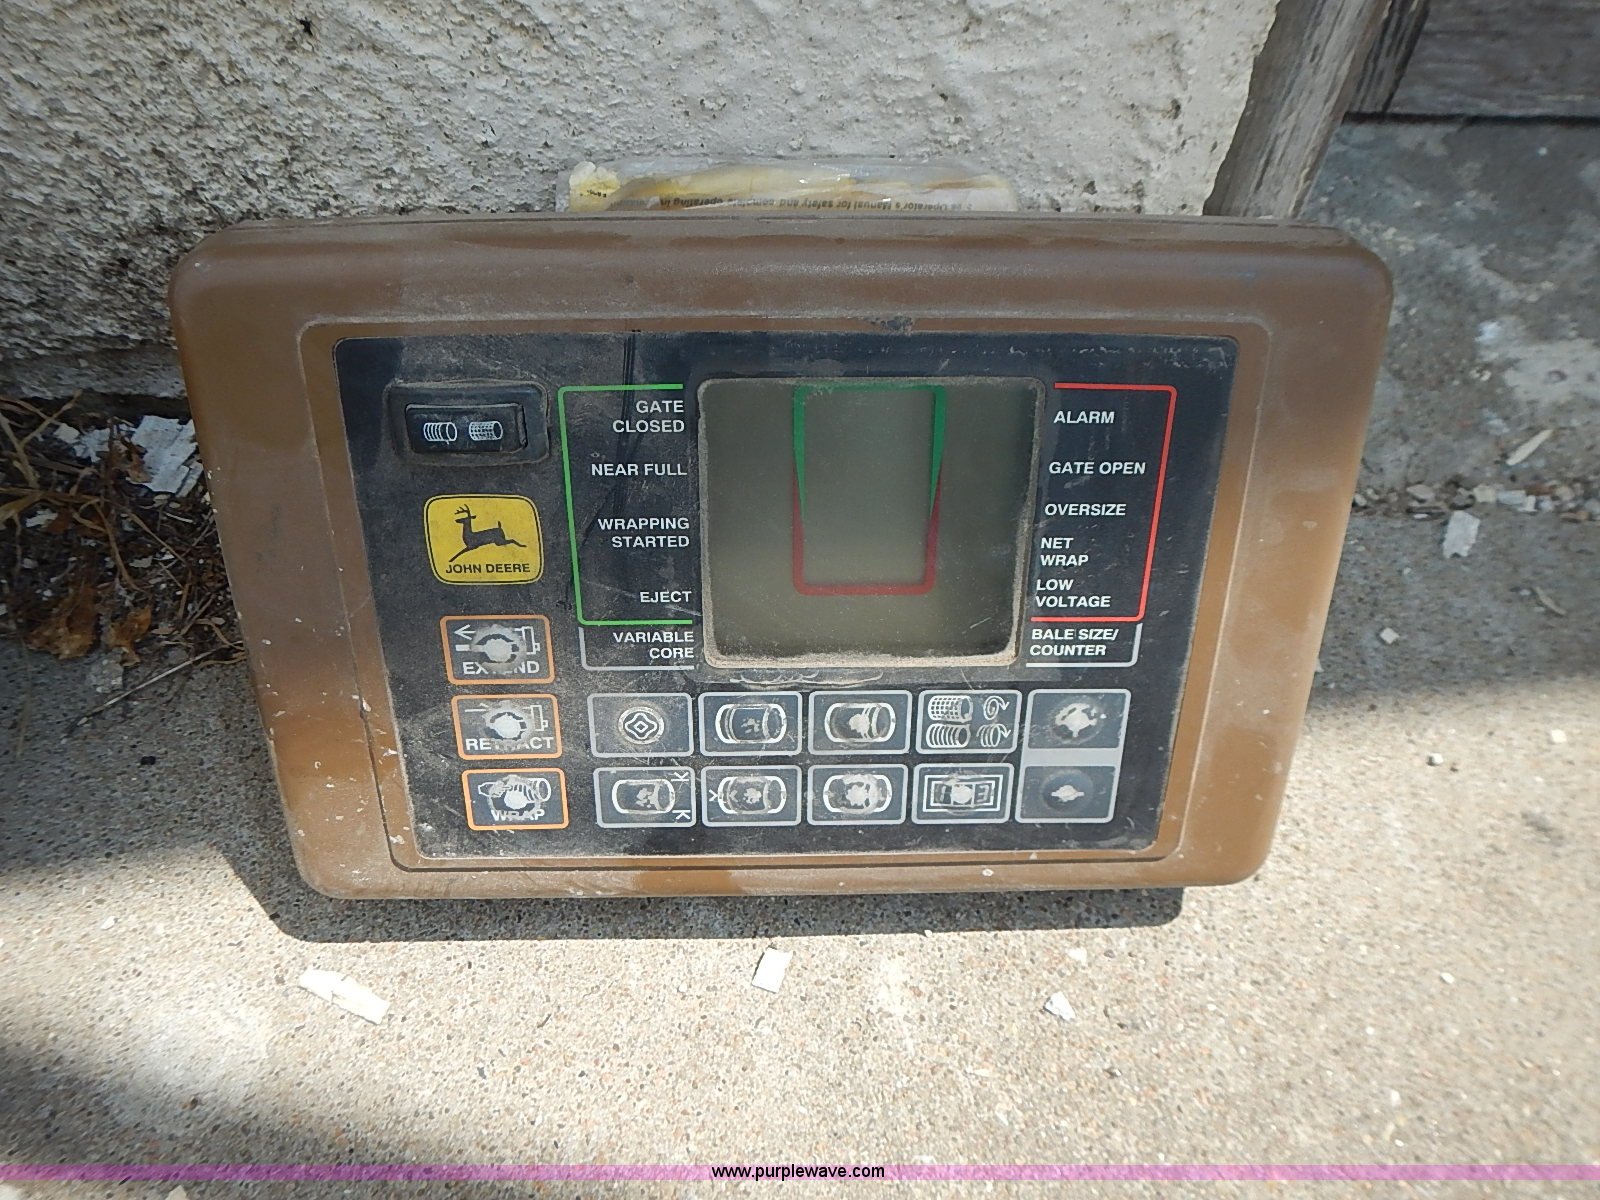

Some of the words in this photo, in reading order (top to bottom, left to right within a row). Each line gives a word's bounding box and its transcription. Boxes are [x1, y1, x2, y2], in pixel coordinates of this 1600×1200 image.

[801, 198, 833, 210] safety
[836, 199, 851, 210] for
[855, 199, 892, 210] Manual
[636, 400, 685, 414] GATE
[1053, 410, 1115, 424] ALARM
[612, 419, 685, 433] CLOSED
[591, 463, 639, 477] NEAR
[644, 463, 688, 477] FULL
[1048, 461, 1094, 475] GATE
[1099, 461, 1146, 475] OPEN
[1044, 503, 1126, 517] OVERSIZE
[597, 517, 690, 531] WRAPPING
[611, 535, 690, 549] STARTED
[1040, 537, 1074, 550] NET
[1040, 554, 1089, 567] WRAP
[445, 563, 482, 575] JOHN
[485, 562, 531, 574] DEERE
[1036, 579, 1074, 591] LOW
[639, 590, 692, 604] EJECT
[1035, 595, 1111, 608] VOLTAGE
[612, 630, 695, 643] VARIABLE
[1031, 628, 1075, 641] BALE
[1078, 628, 1119, 641] SIZE/
[649, 646, 695, 659] CORE
[1029, 644, 1107, 657] COUNTER
[462, 661, 540, 675] EXND
